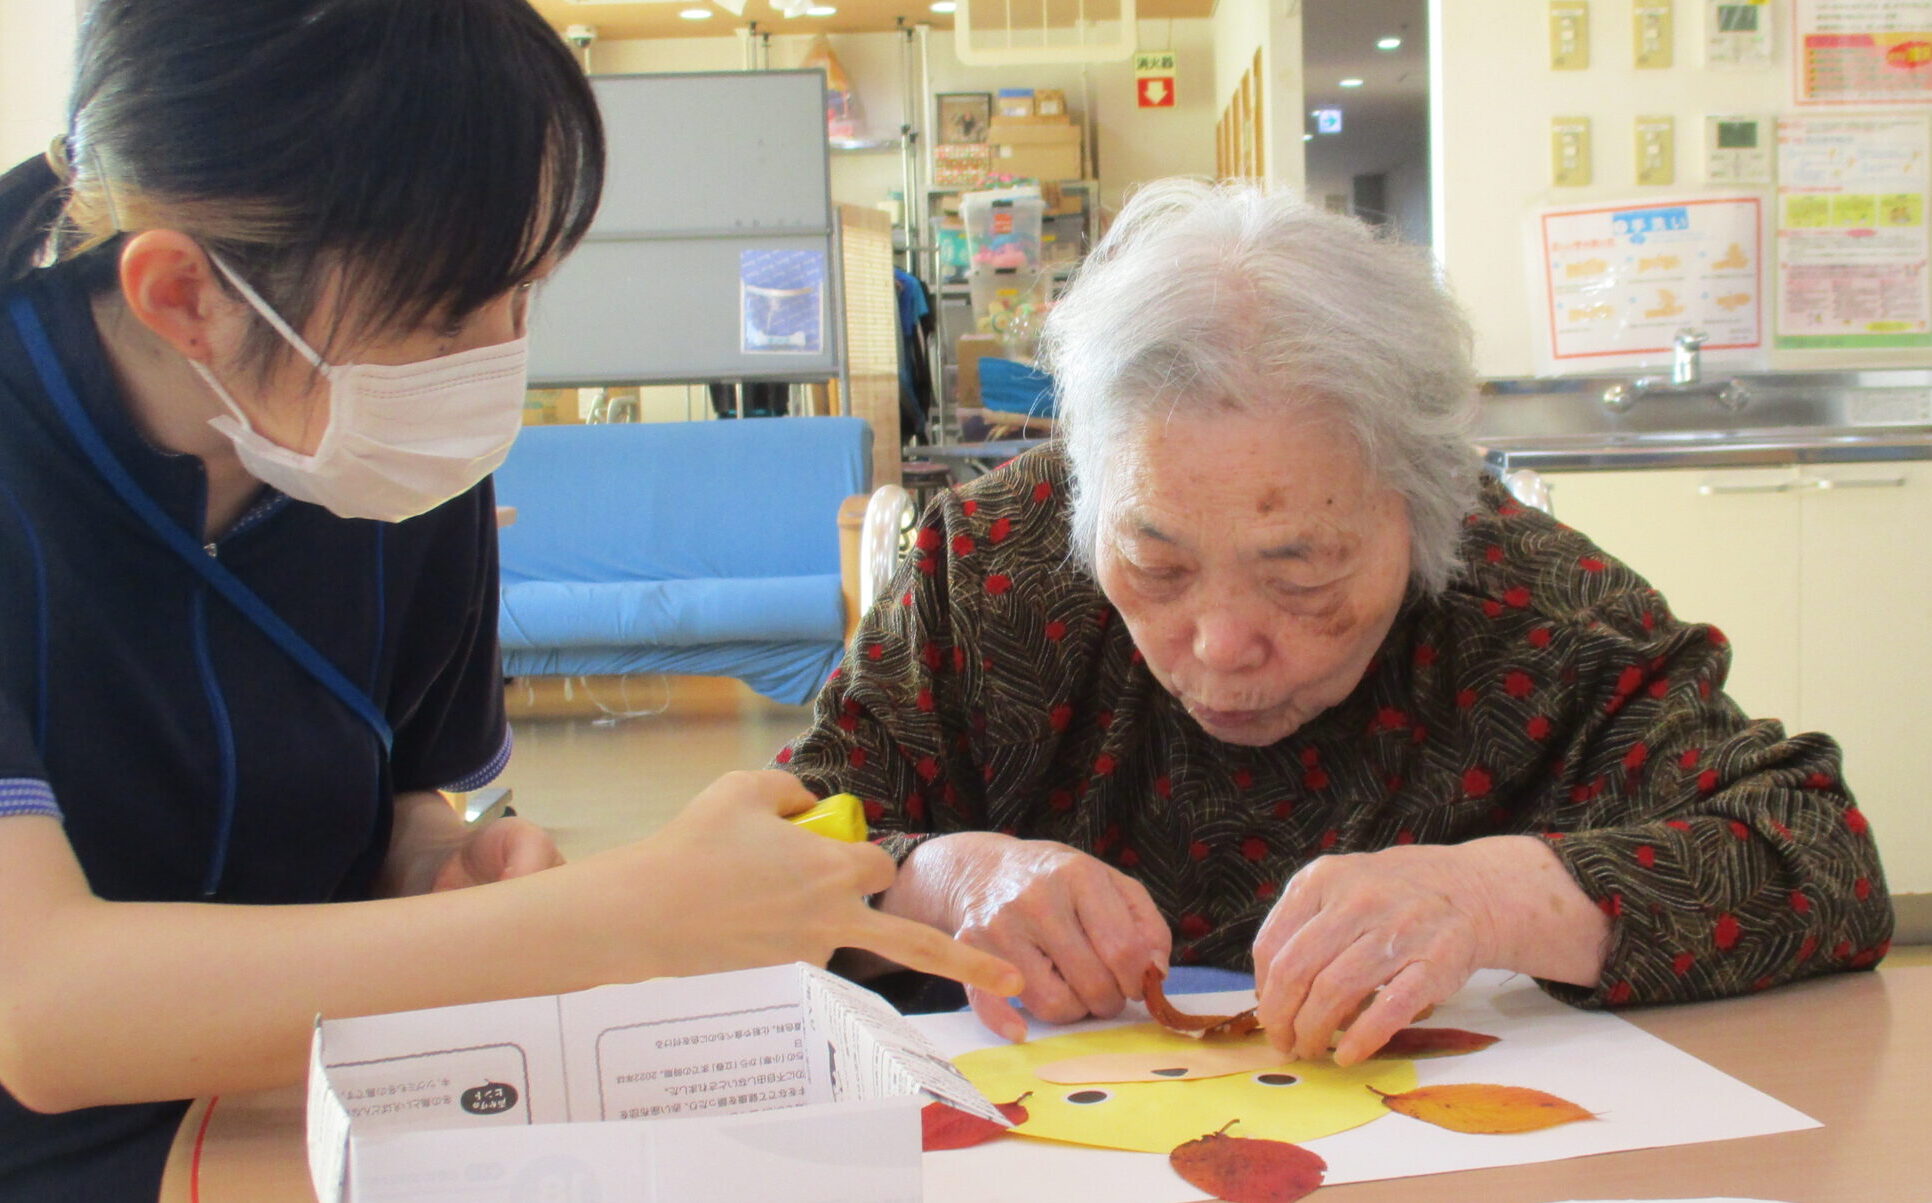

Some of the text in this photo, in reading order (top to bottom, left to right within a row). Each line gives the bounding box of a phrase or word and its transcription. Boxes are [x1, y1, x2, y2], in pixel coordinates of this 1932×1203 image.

[1136, 56, 1174, 70] 消火器
[473, 1088, 503, 1099] ヒント
[346, 1095, 453, 1117] 冬の鳥といえばどんな
[472, 1097, 507, 1109] 声かけの
